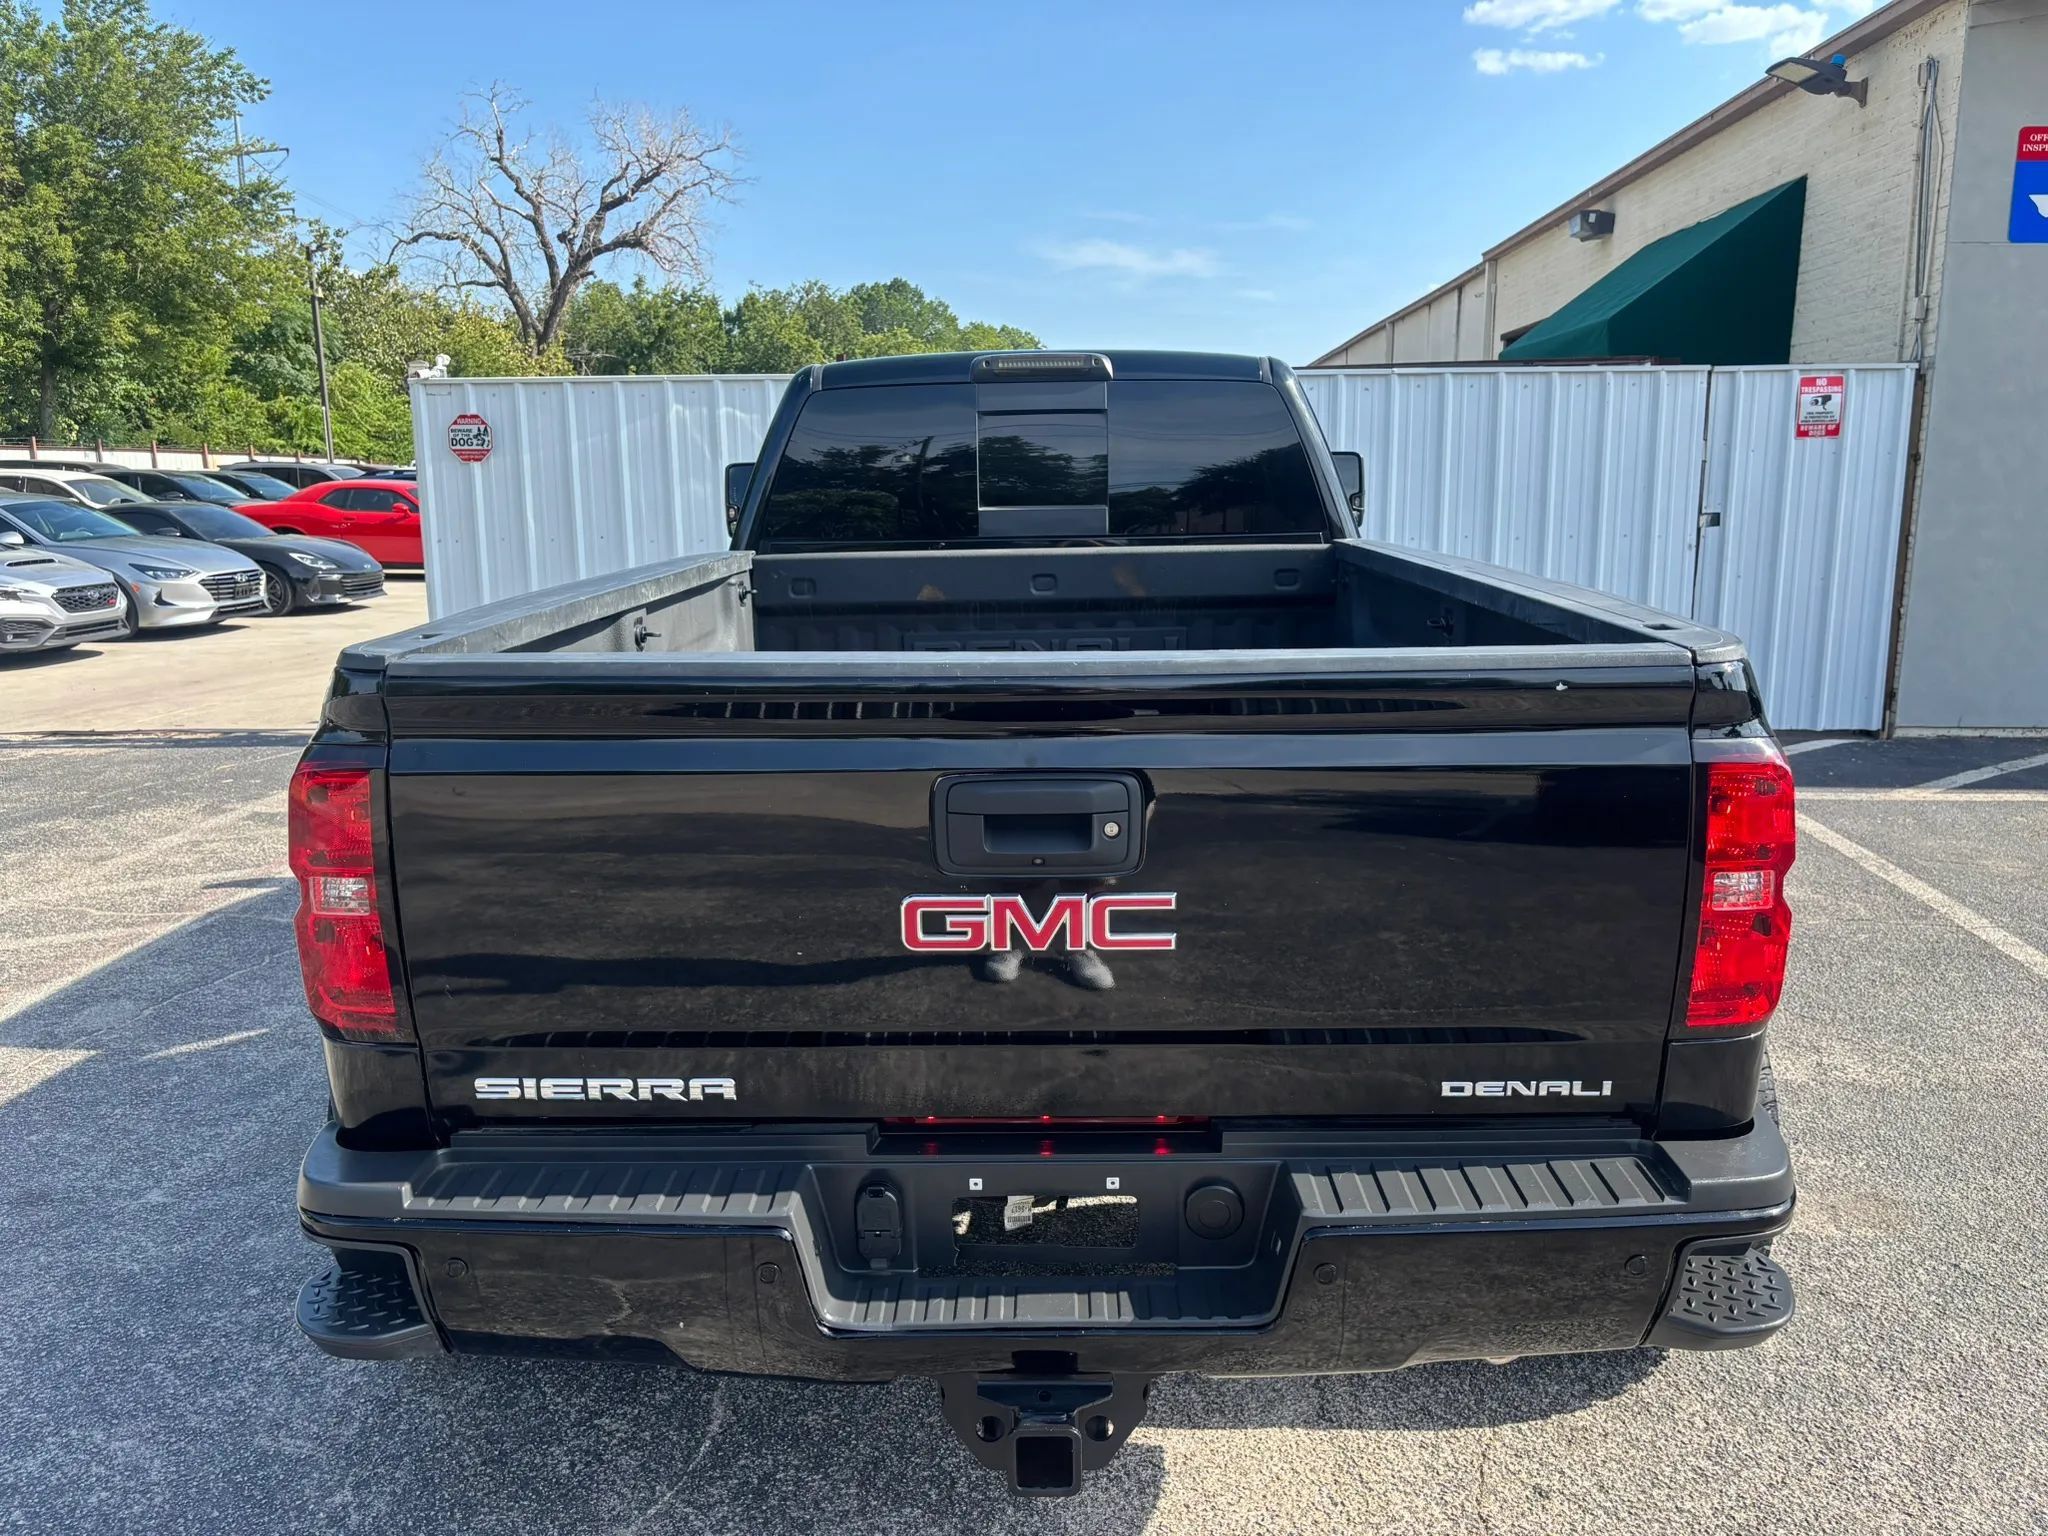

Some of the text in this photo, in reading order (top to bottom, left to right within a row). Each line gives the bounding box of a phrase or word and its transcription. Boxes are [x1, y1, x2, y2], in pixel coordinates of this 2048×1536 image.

[2030, 133, 2048, 142] OFF
[1816, 378, 1827, 386] NO
[451, 438, 474, 447] DOG
[901, 893, 1177, 951] GMC
[474, 1077, 737, 1101] SIERRA
[1441, 1081, 1612, 1097] DENALI
